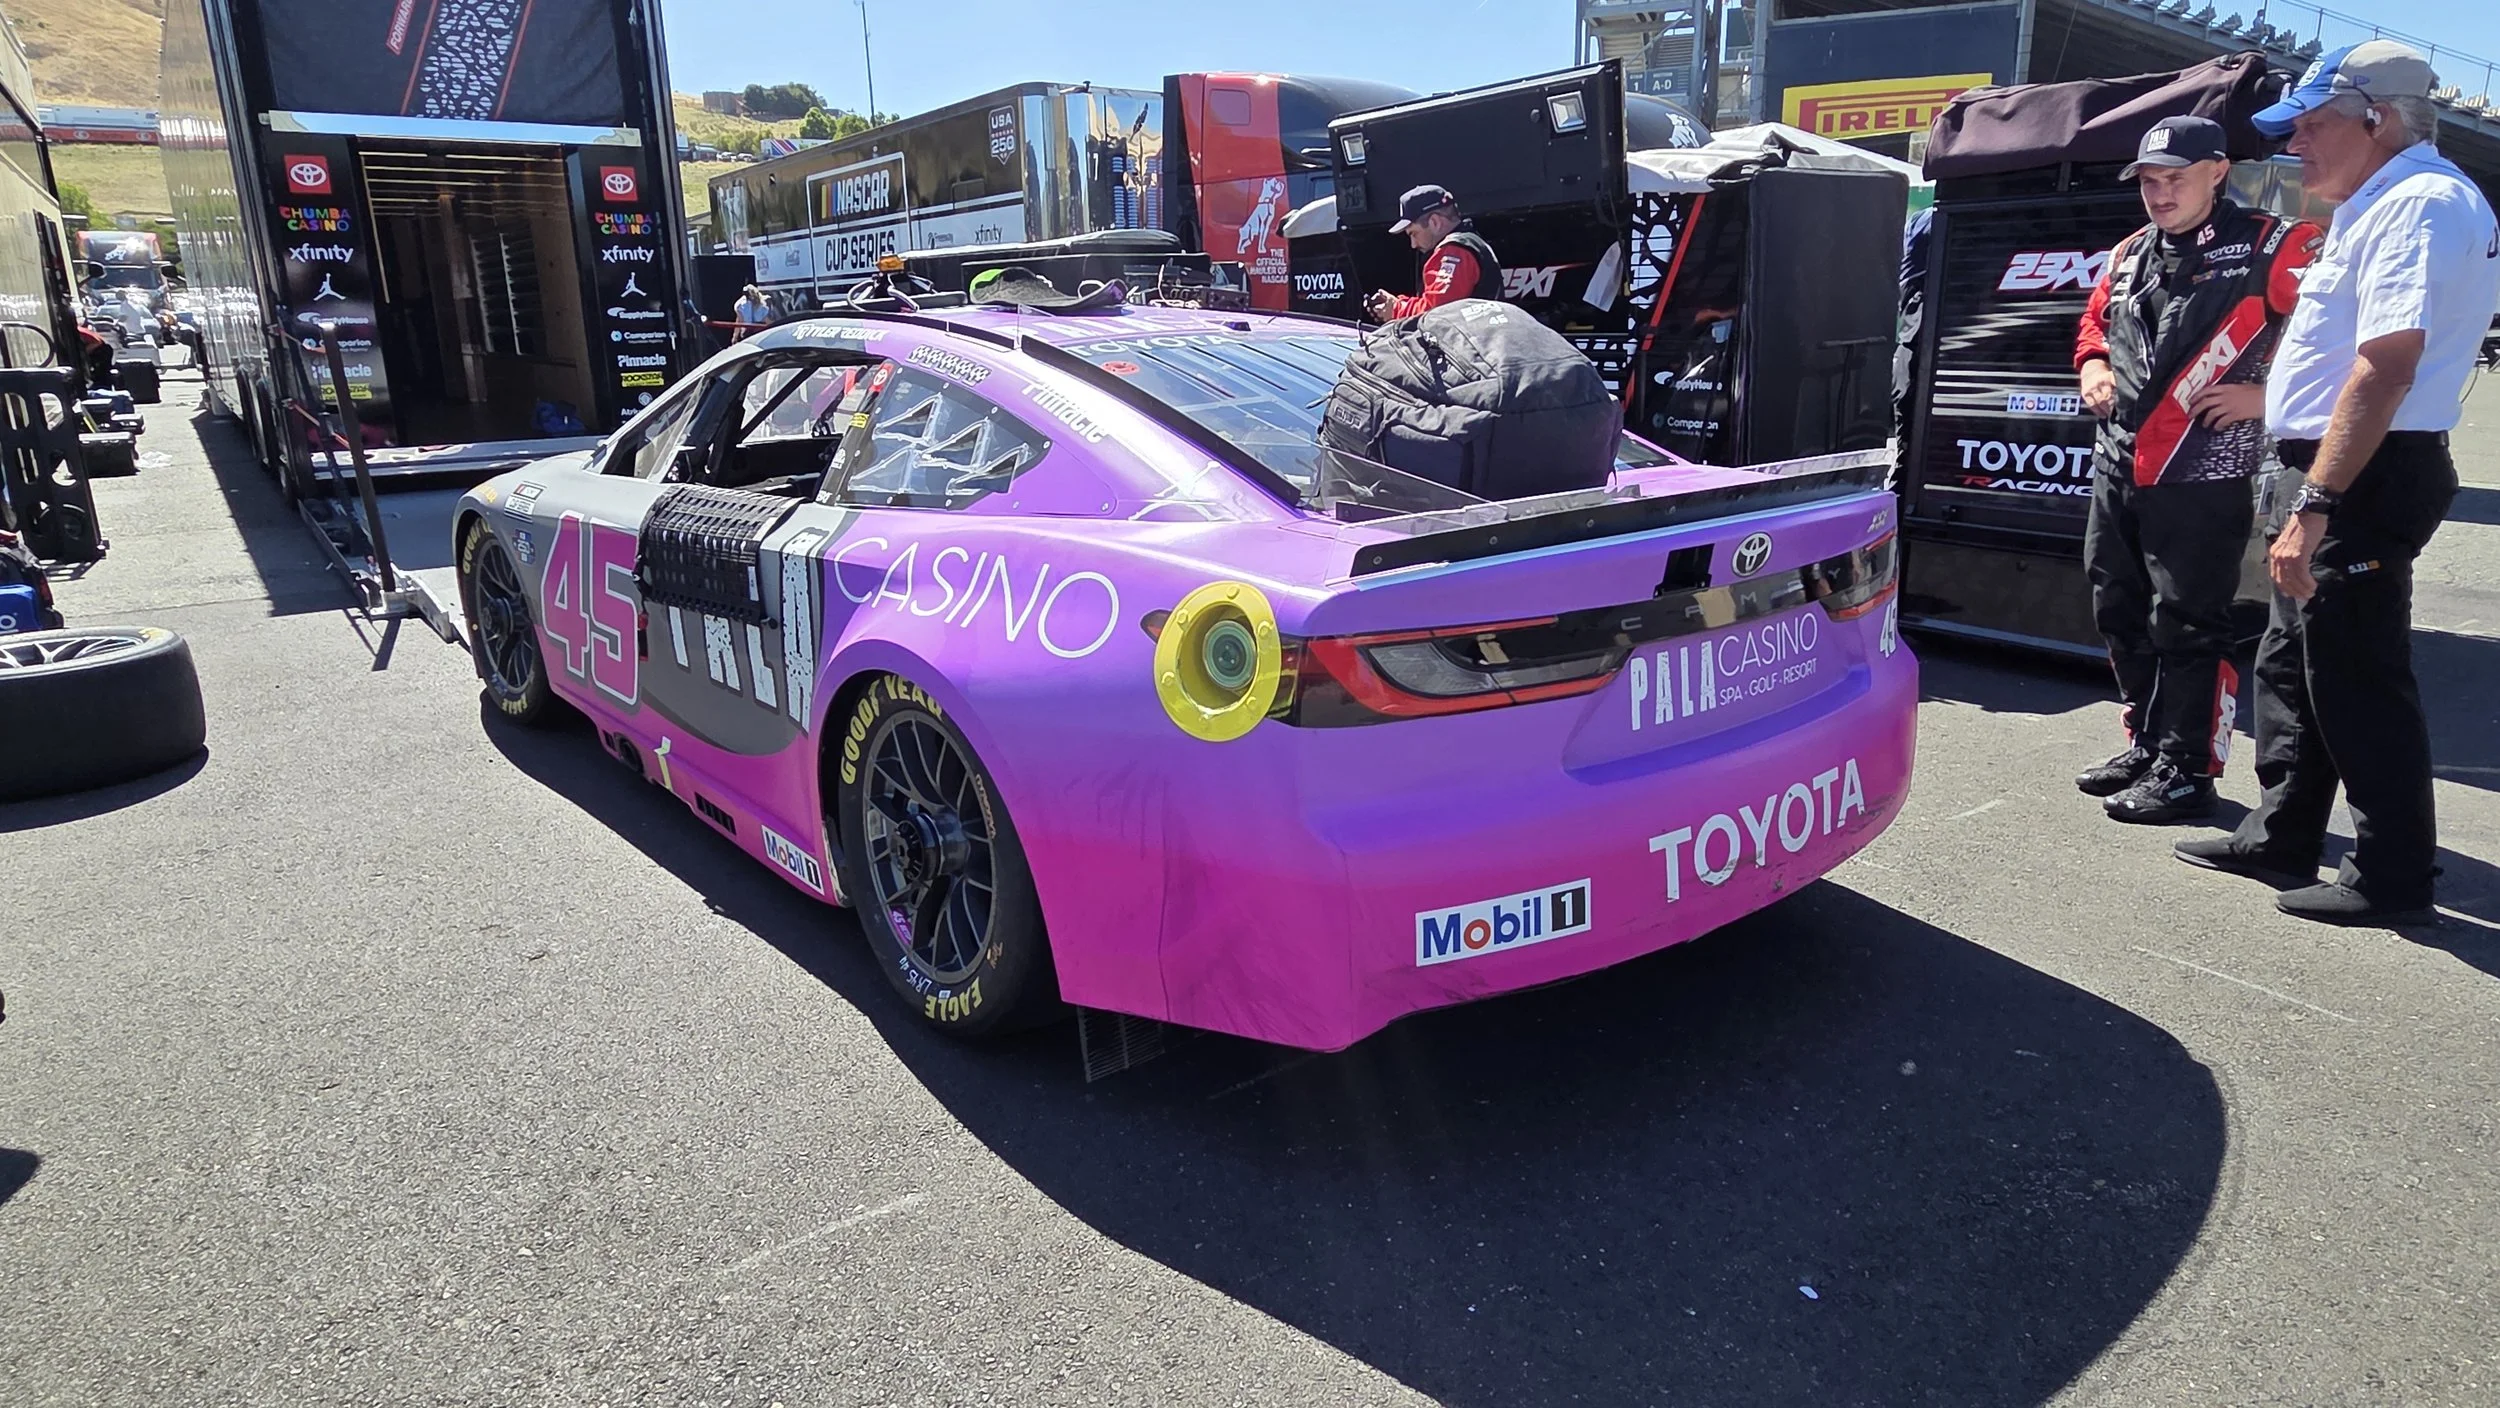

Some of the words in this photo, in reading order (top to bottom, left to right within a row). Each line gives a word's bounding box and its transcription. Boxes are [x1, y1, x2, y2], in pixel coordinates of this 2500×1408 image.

[391, 0, 413, 50] FORWAR
[991, 113, 1013, 129] USA
[991, 135, 1015, 154] 250
[835, 169, 890, 216] NASCAR
[279, 206, 352, 219] CHUMBA
[595, 212, 653, 223] CHUMBA
[287, 219, 349, 232] CASINO
[601, 223, 652, 235] CASINO
[2197, 224, 2216, 246] 45
[288, 243, 354, 263] xfinity
[601, 245, 655, 263] xfinity
[825, 236, 849, 272] CUP
[850, 230, 895, 269] SERIES
[1270, 248, 1284, 257] THE
[2204, 243, 2252, 260] TOYOTA
[1256, 257, 1287, 266] OFFICIAL
[1294, 273, 1345, 291] TOYOTA
[1065, 335, 1242, 357] TOYOTA
[617, 353, 667, 367] Pinnacle
[2009, 395, 2058, 412] Mobil
[1667, 416, 1718, 430] Comparon
[1957, 439, 2095, 479] TOYOT
[832, 536, 1120, 658] CASINO
[541, 510, 639, 706] 45
[1630, 640, 1717, 731] PALA
[1717, 612, 1819, 677] CASINO
[1719, 686, 1744, 706] SPA
[1748, 675, 1778, 697] GOLF
[1782, 658, 1818, 683] RESORT
[1648, 758, 1866, 904] TOYOTA
[764, 830, 806, 879] Mobil
[809, 860, 822, 890] 1
[1422, 896, 1542, 958] Mobil
[924, 975, 983, 1022] EAGLE
